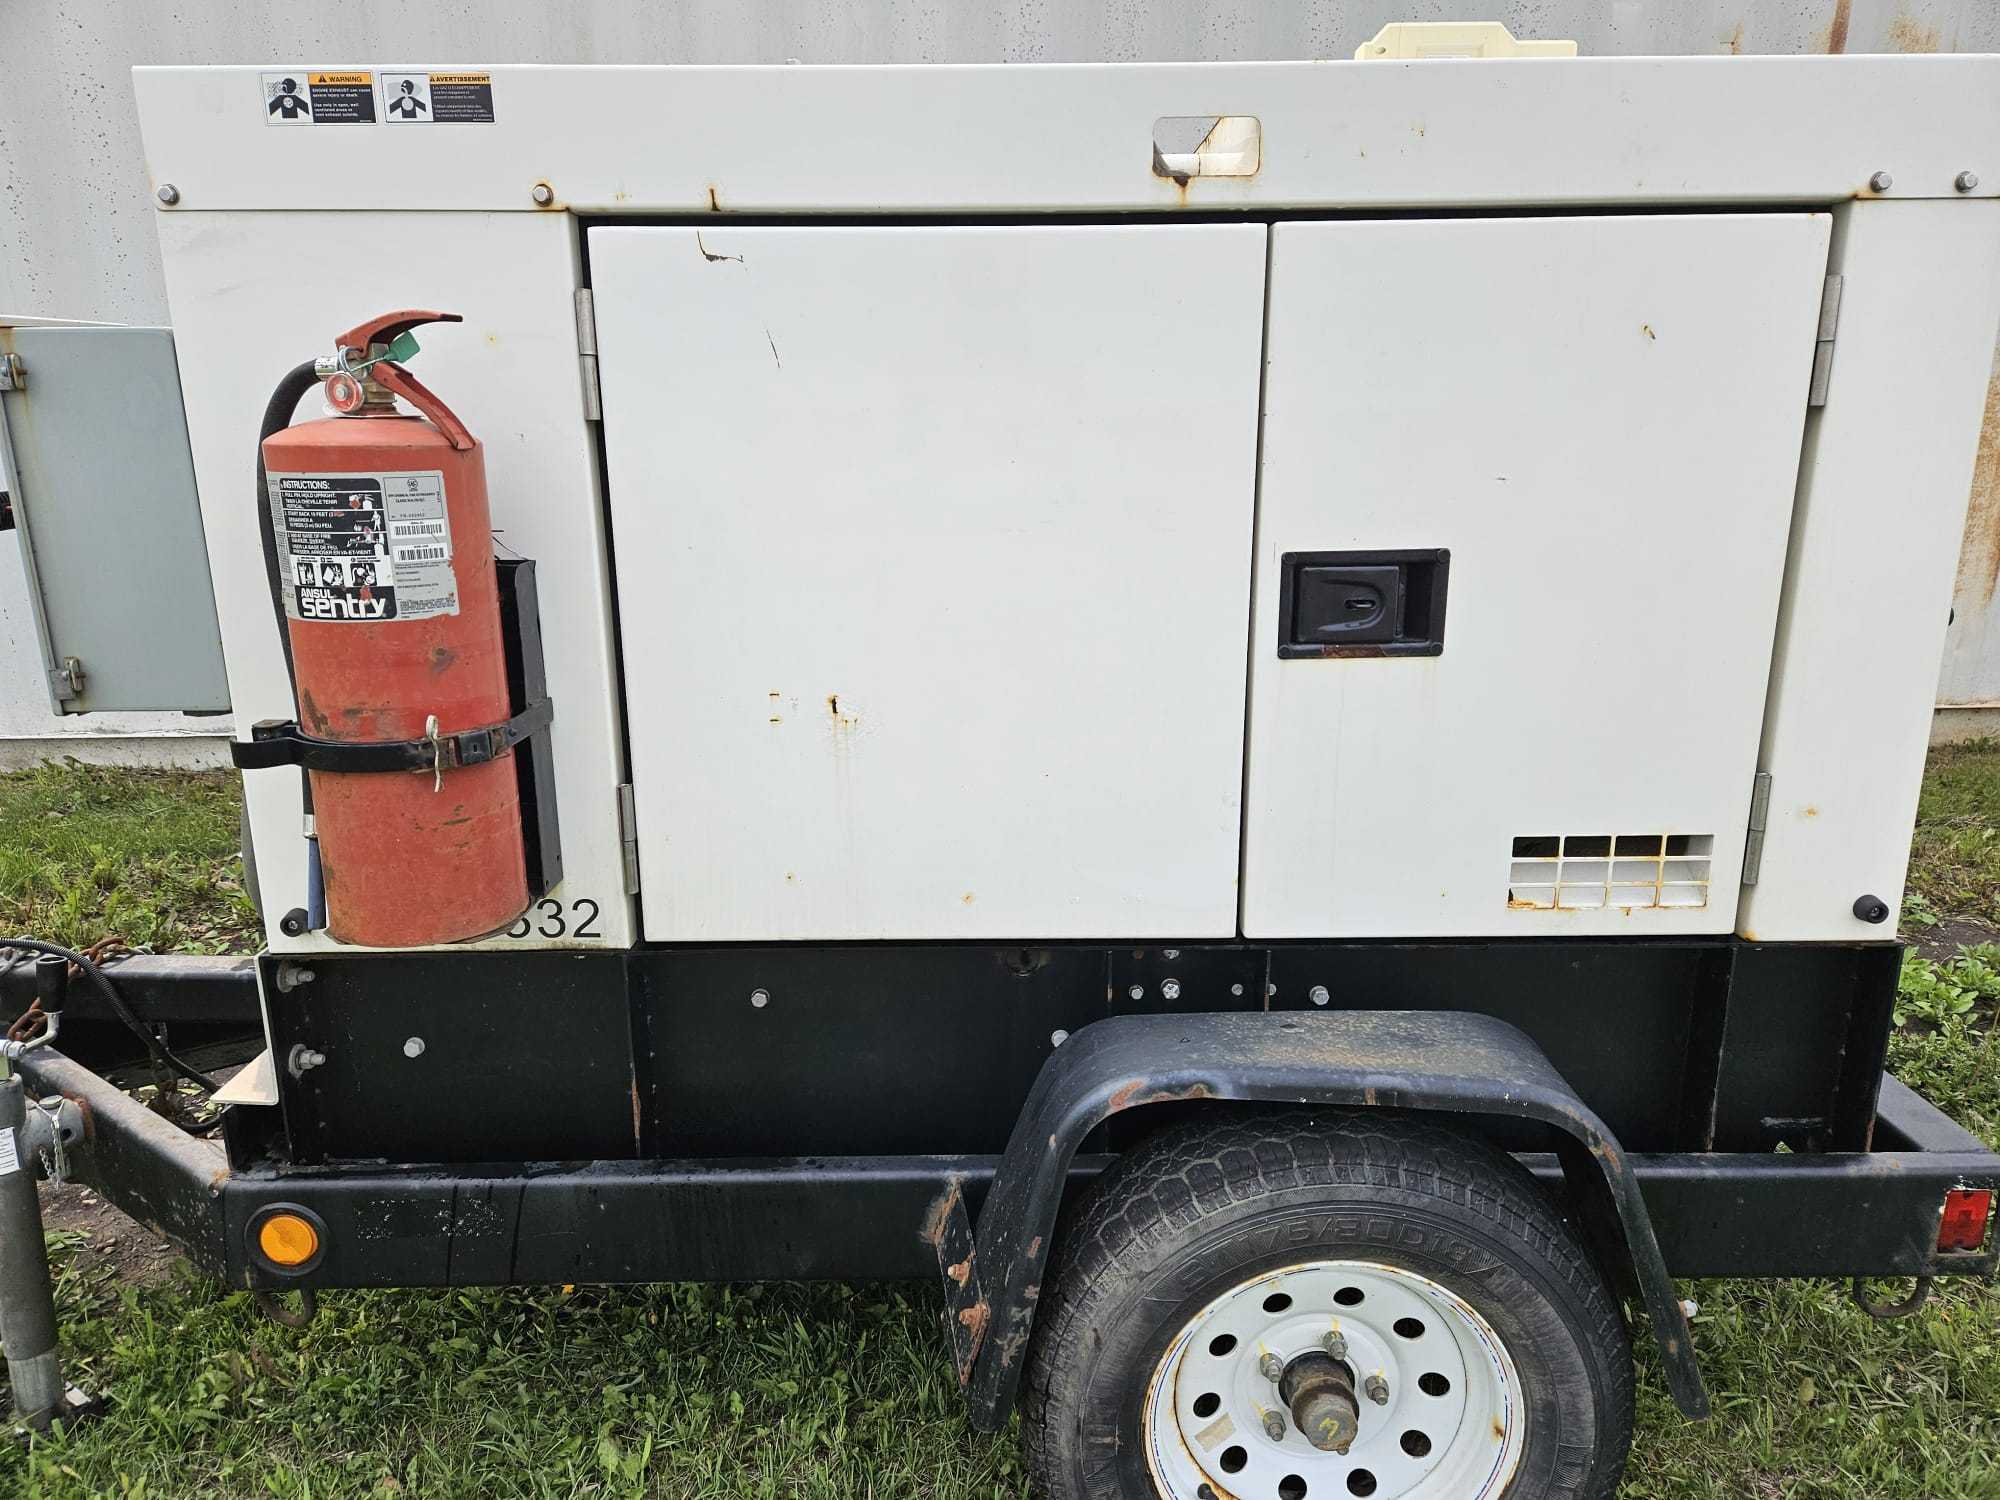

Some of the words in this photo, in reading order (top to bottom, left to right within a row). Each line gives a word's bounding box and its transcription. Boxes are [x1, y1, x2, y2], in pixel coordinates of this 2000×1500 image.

[329, 75, 362, 83] WARNING
[280, 480, 330, 490] INSTRUCTIONS:
[301, 588, 335, 598] ANSUL
[301, 592, 386, 618] sentry
